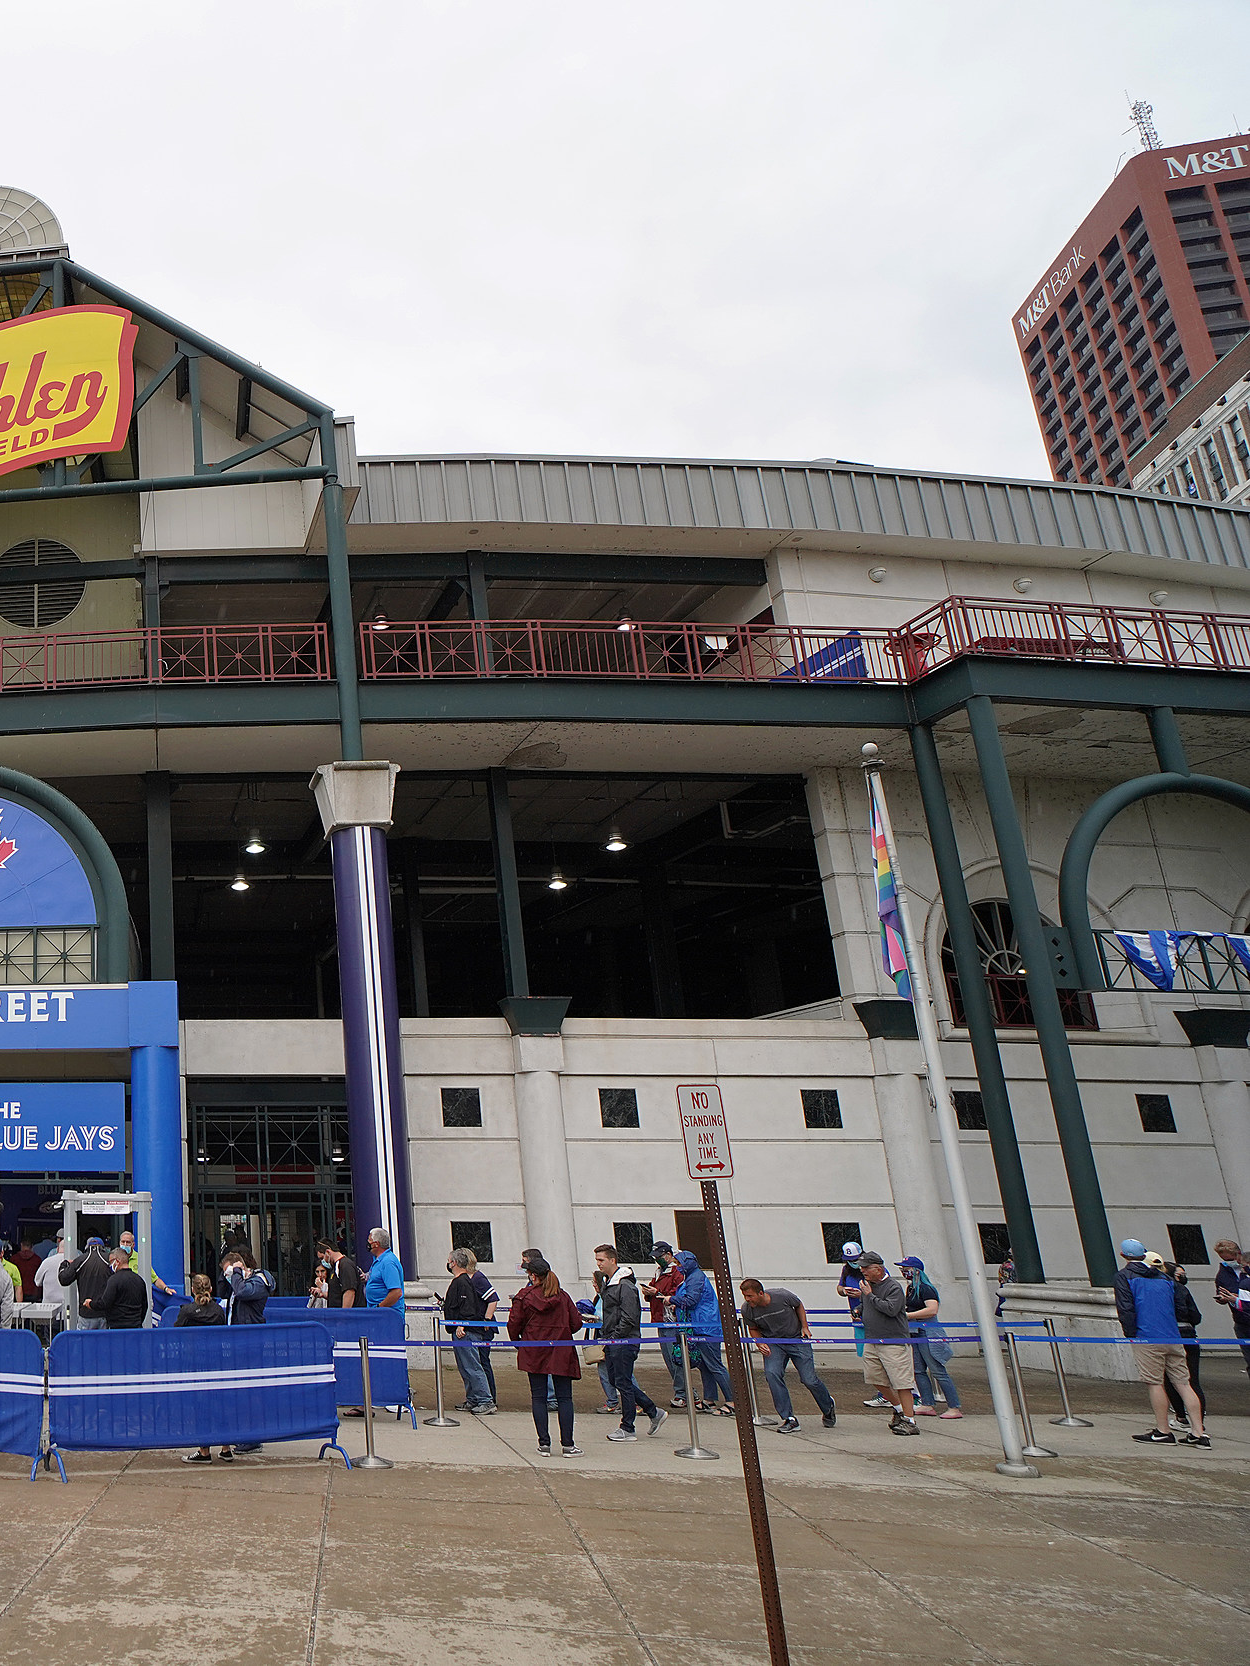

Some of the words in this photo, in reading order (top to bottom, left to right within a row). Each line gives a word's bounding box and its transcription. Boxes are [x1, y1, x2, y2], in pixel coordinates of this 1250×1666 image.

[1162, 145, 1249, 179] M&T
[1018, 282, 1051, 338] M&T
[1049, 245, 1086, 297] Bank
[691, 1092, 709, 1109] NO
[684, 1115, 723, 1128] STANDING
[44, 1125, 115, 1151] JAYS
[698, 1133, 715, 1144] ANY
[698, 1147, 718, 1159] TIME
